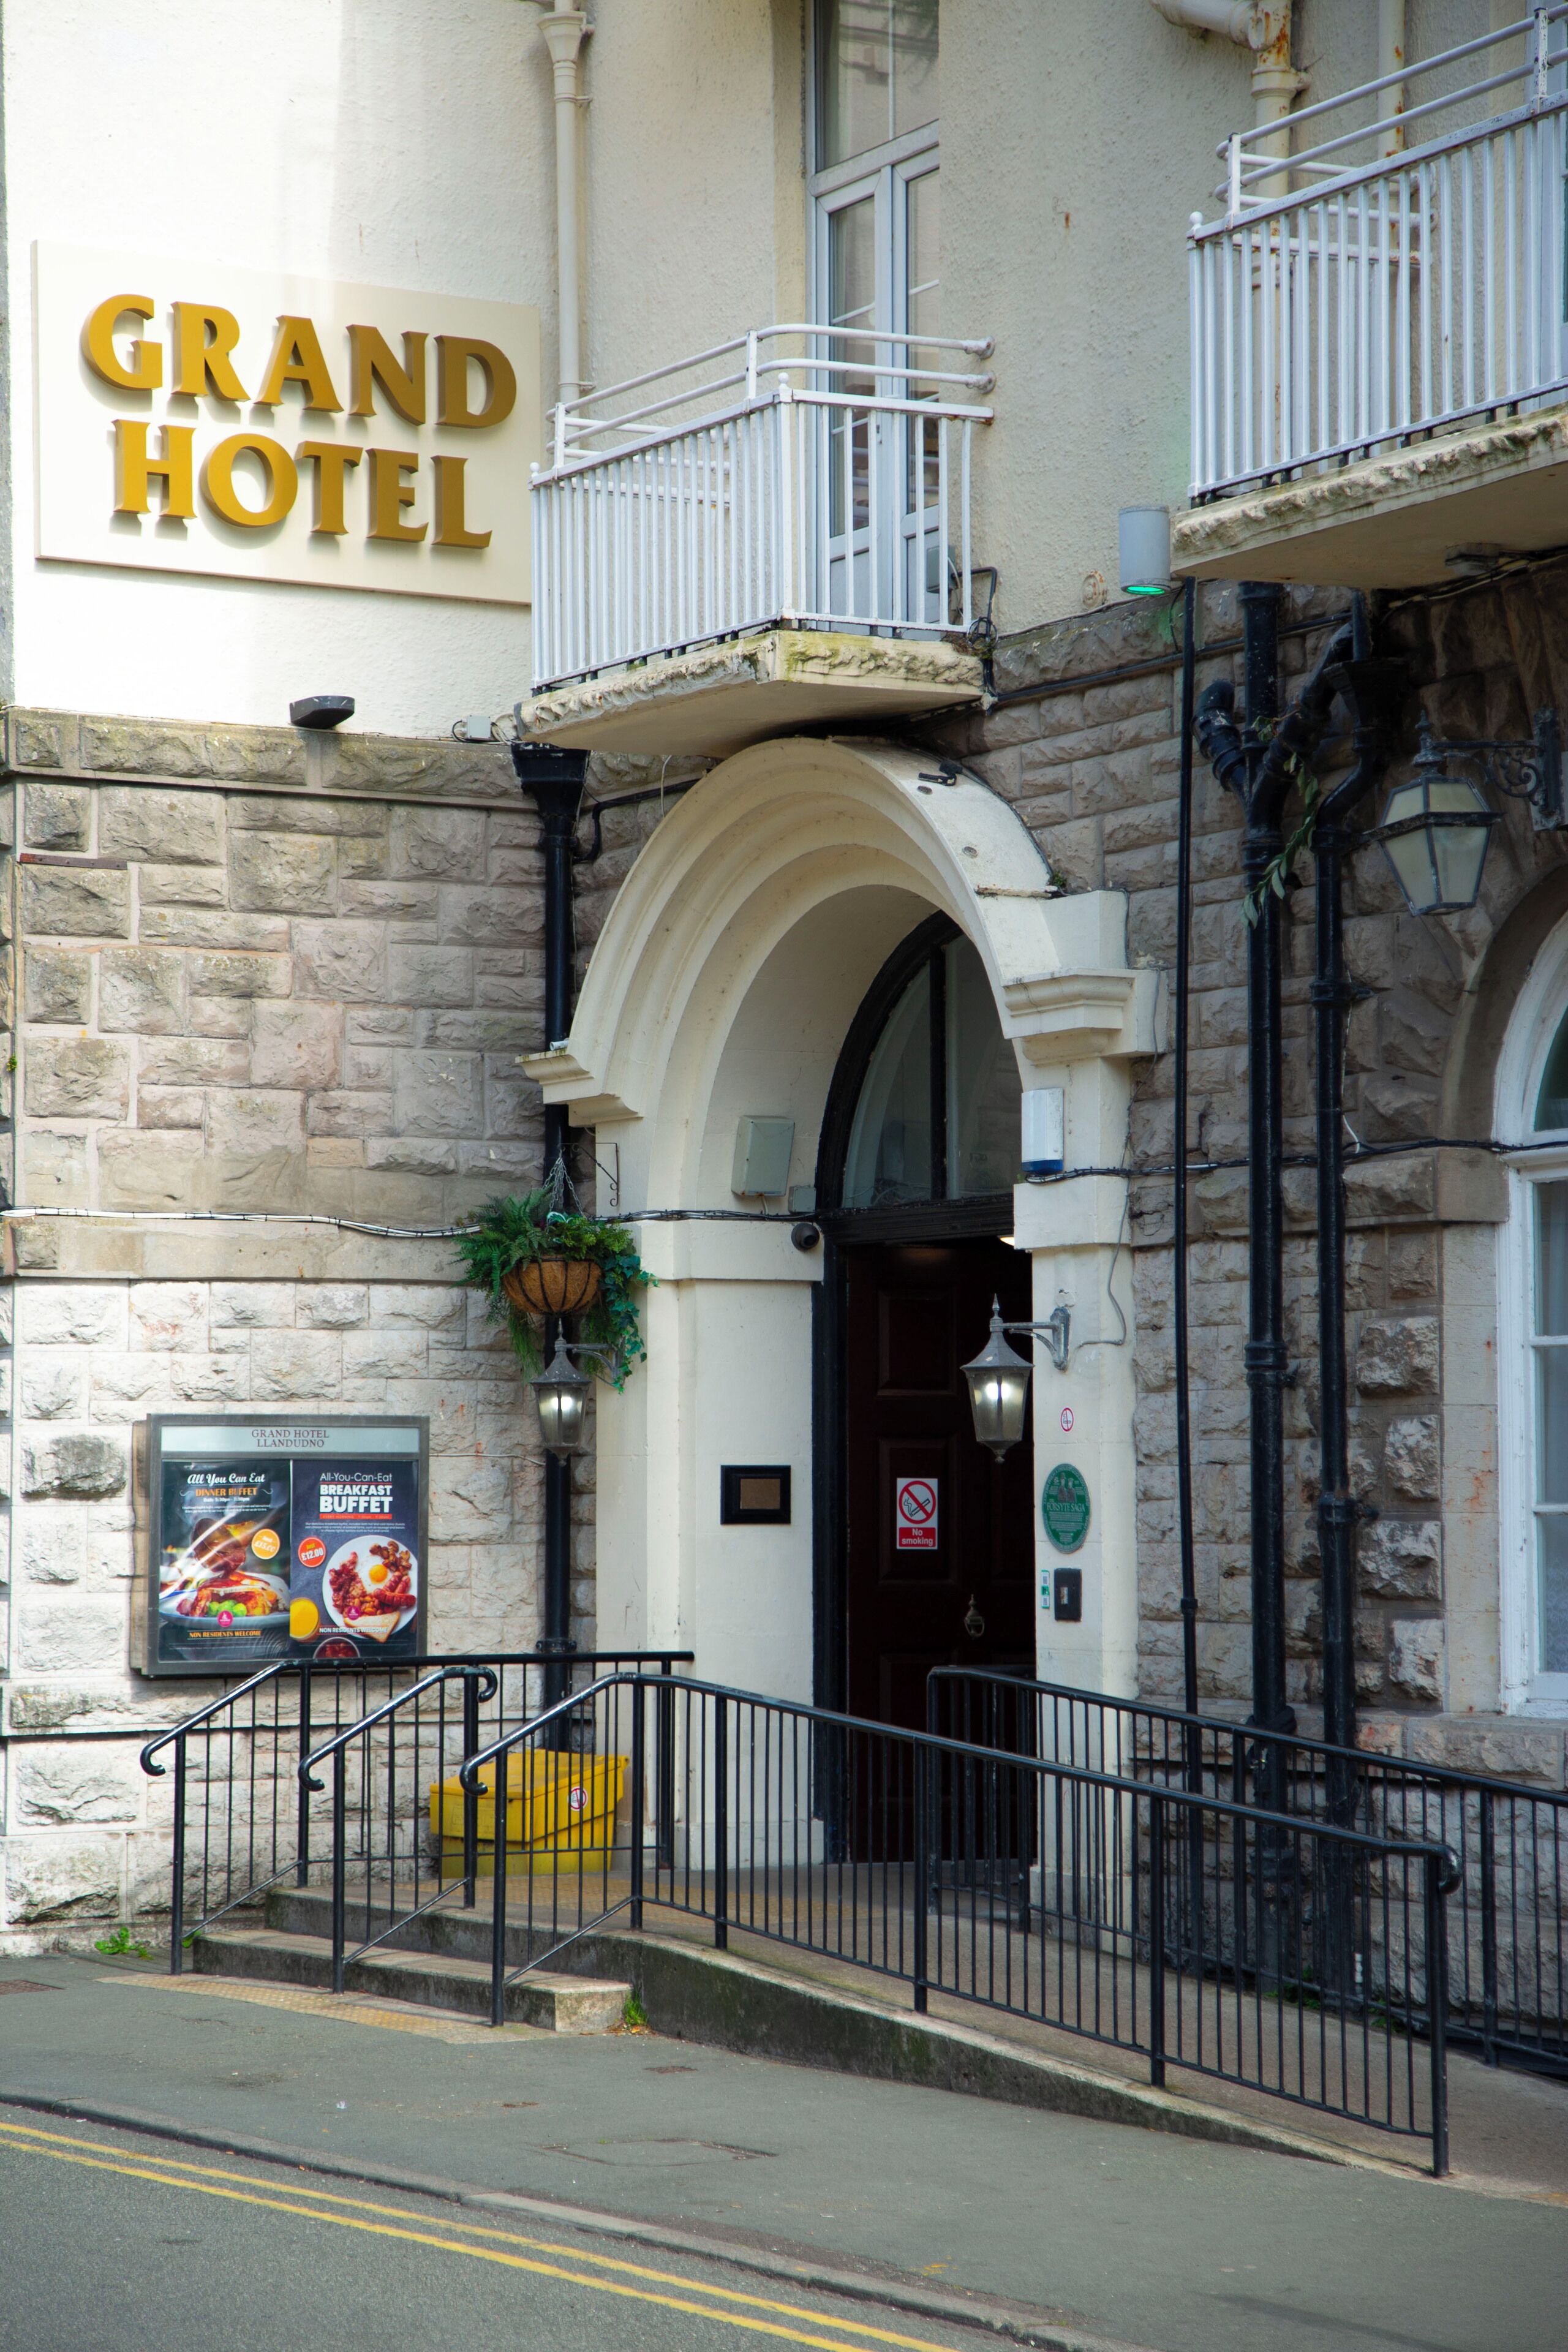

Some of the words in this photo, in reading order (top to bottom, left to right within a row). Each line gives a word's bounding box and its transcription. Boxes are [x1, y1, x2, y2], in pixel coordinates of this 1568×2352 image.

[81, 293, 517, 428] GRAND
[112, 418, 492, 549] HOTEL
[251, 1429, 291, 1438] GRAND
[293, 1430, 330, 1438] HOTEL
[257, 1439, 325, 1448] LLANDUDNO
[187, 1474, 205, 1484] All
[206, 1473, 227, 1487] You
[228, 1472, 247, 1483] Can
[249, 1472, 265, 1483] Eat
[319, 1472, 393, 1482] All-You-Can-Eat
[195, 1488, 226, 1497] DINNER
[228, 1487, 258, 1496] BUFFET
[320, 1485, 393, 1495] BREAKFAST
[319, 1496, 393, 1513] BUFFET
[1047, 1502, 1070, 1511] FORSYTE
[1071, 1502, 1085, 1512] SAGA
[901, 1537, 933, 1547] smoking
[301, 1547, 324, 1561] £12.00
